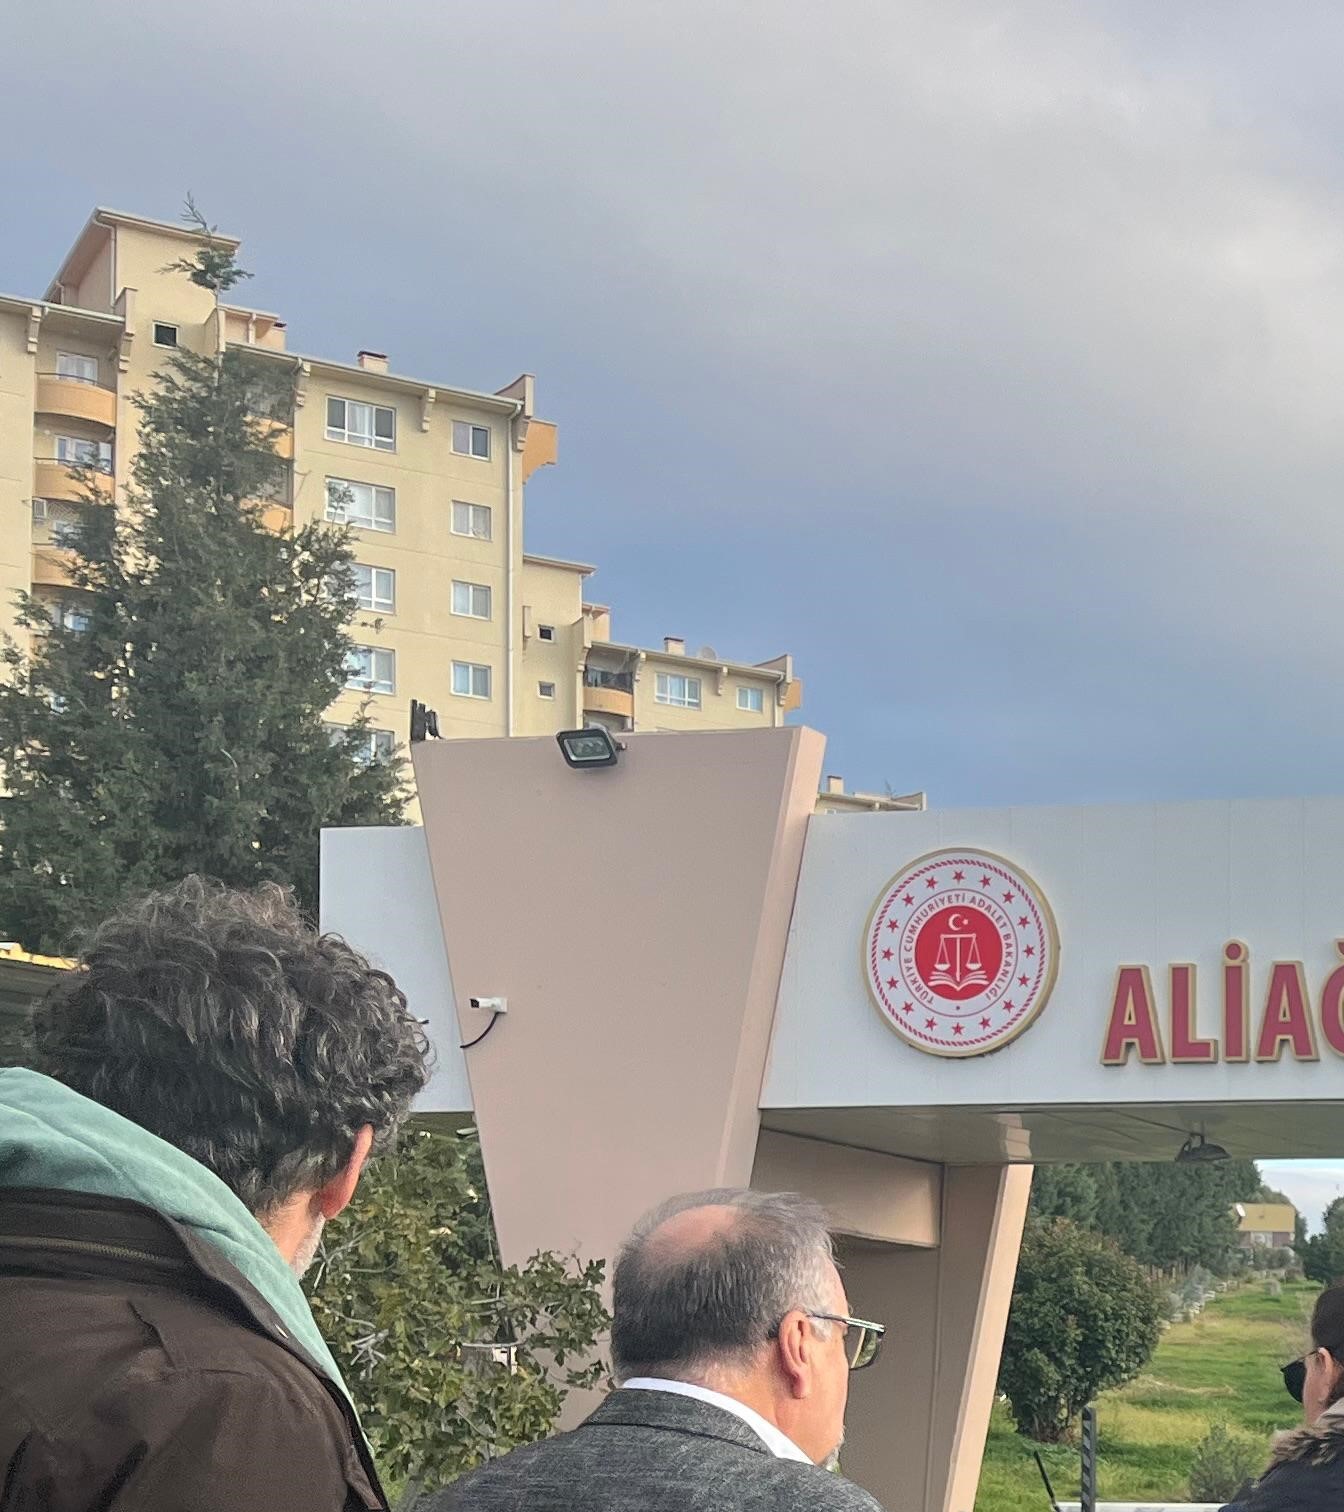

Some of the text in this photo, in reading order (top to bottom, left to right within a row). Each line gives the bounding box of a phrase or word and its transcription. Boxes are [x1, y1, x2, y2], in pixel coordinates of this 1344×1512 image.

[903, 893, 1013, 1004] TÜRKİYE CUMHURİYETİ ADALET BAKANLIĞI
